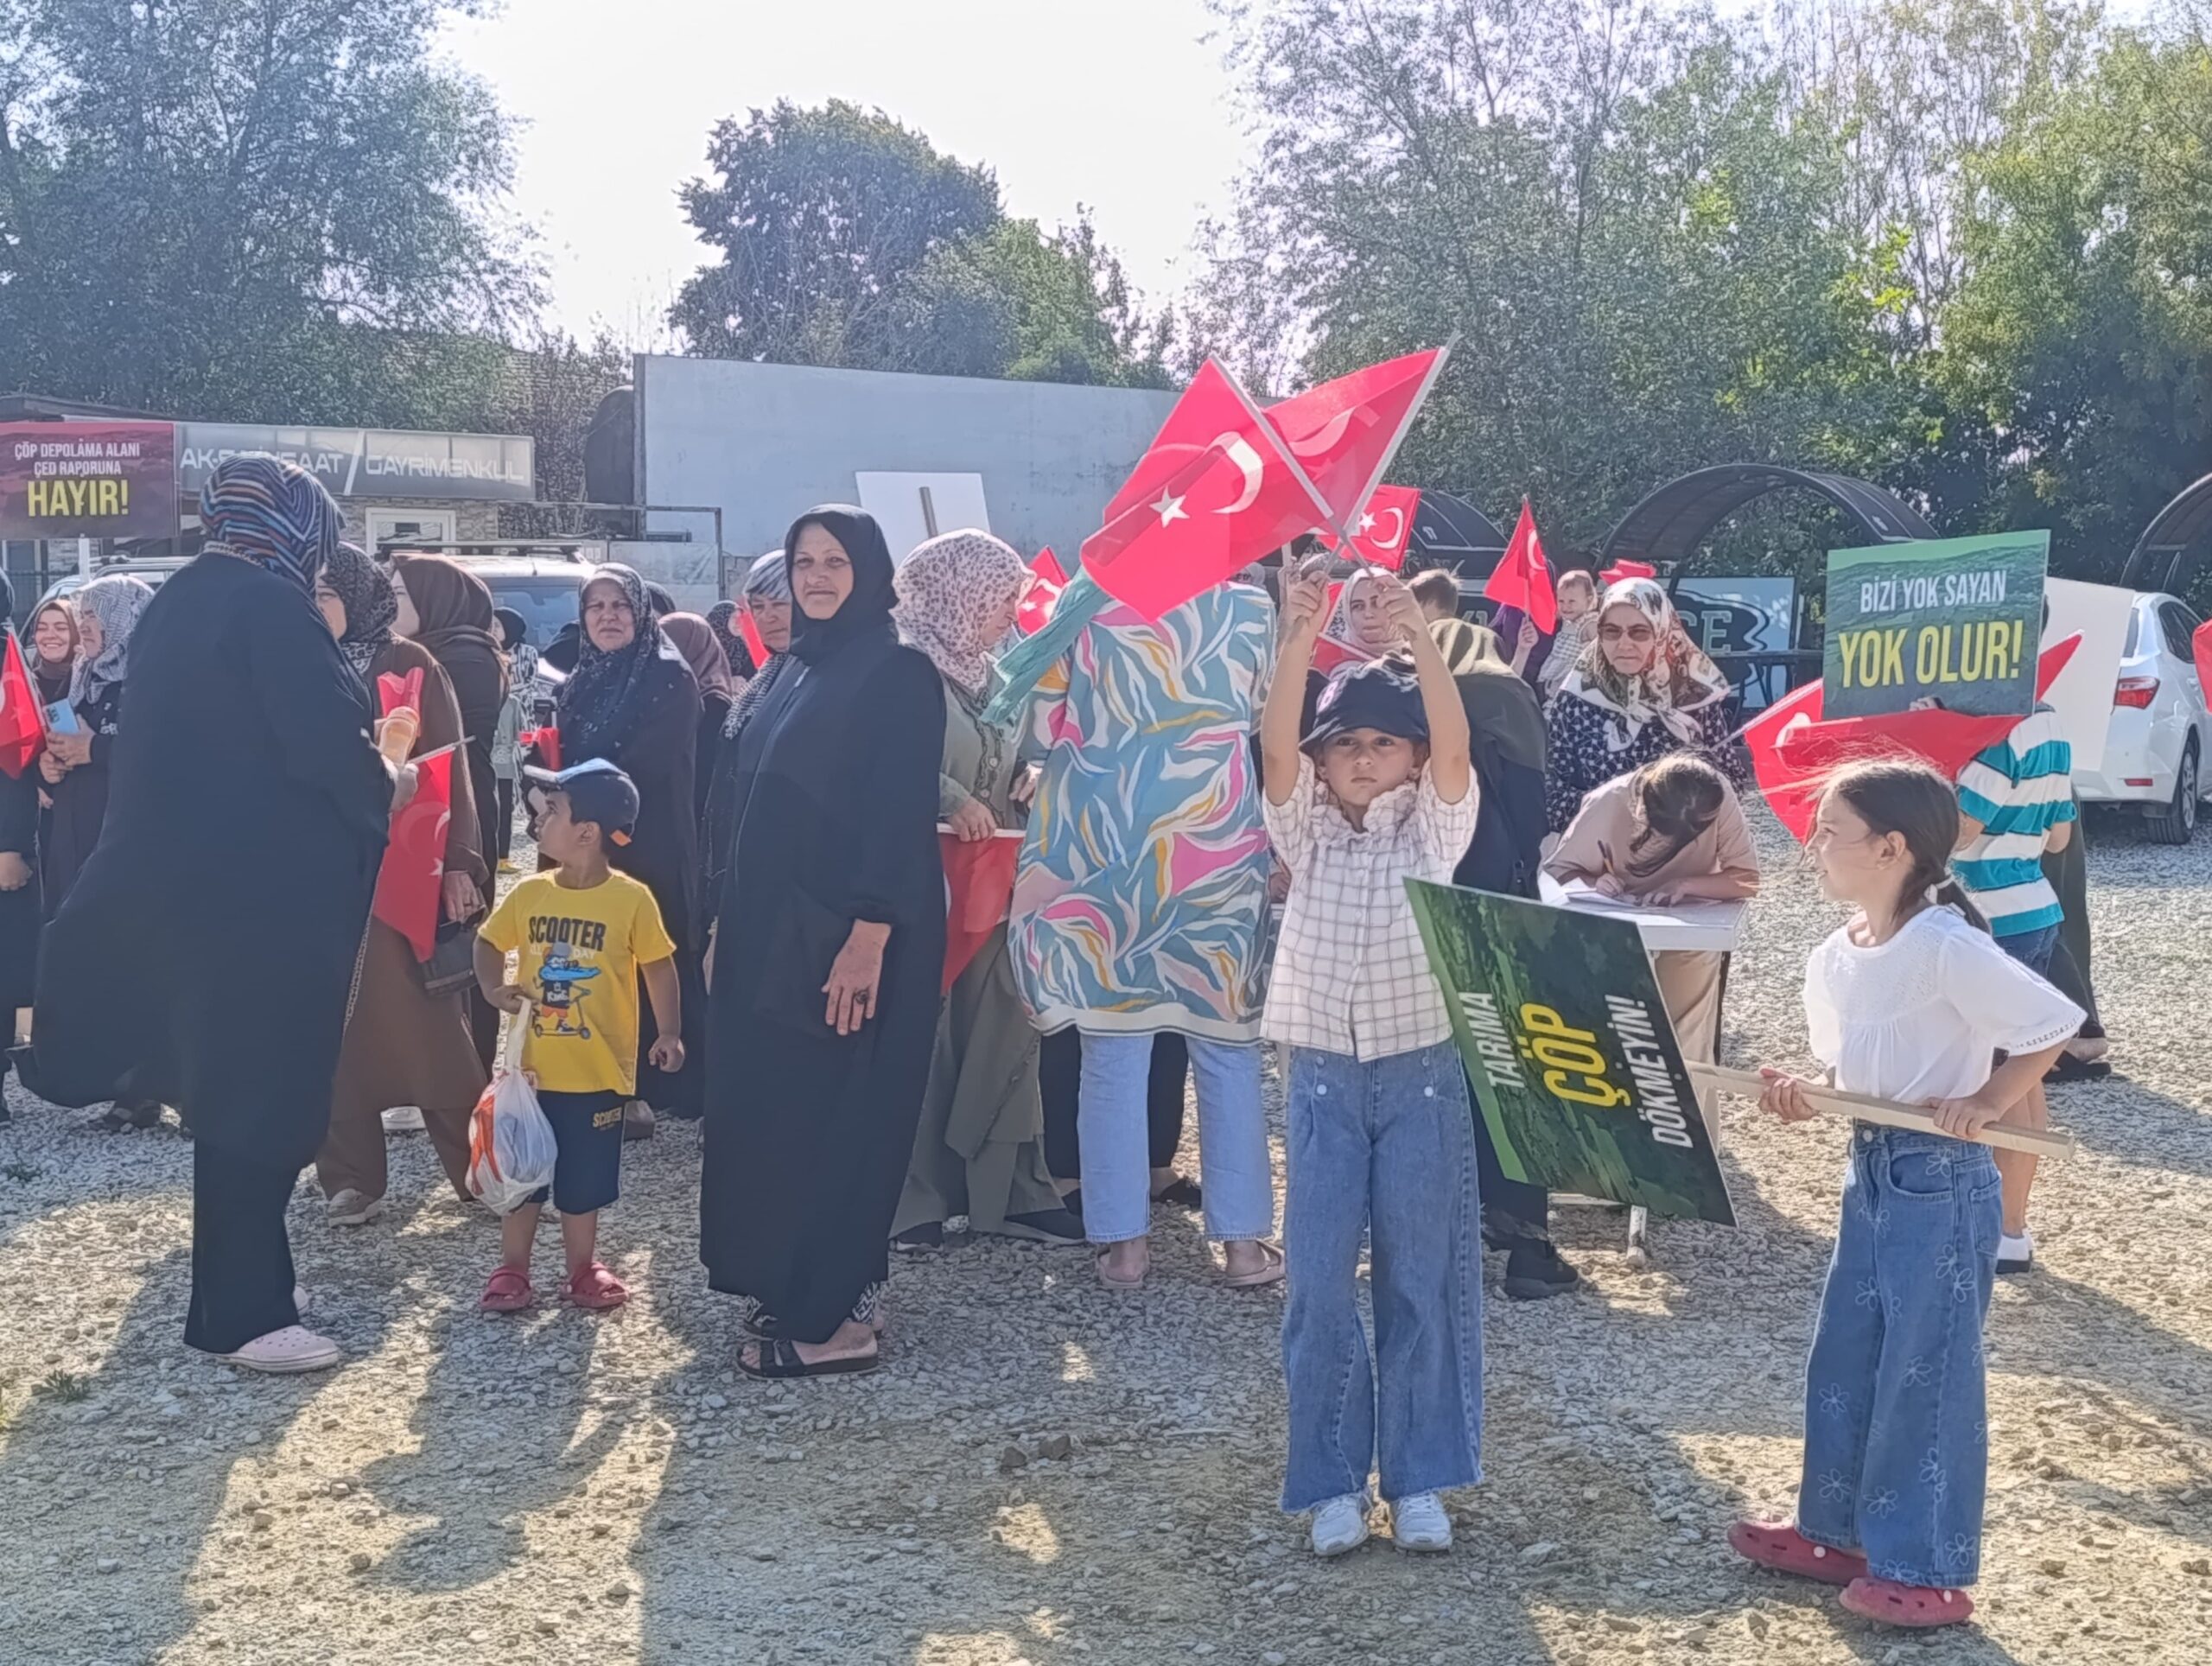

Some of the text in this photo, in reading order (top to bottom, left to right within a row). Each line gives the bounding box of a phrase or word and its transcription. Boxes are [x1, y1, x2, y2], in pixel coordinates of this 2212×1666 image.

[15, 442, 37, 461] ÇÖP
[105, 442, 140, 458] ALANI
[34, 460, 122, 478] ÇED RAPORUNA
[365, 452, 524, 480] GAYRİMENKUL
[28, 480, 129, 517] HAYIR!
[1859, 569, 2006, 614] BİZİ YOK SAYAN
[1838, 620, 2024, 688] YOK OLUR!
[528, 916, 607, 952] SCOOTER
[1459, 992, 1525, 1088] TARIMA
[1516, 1003, 1631, 1107] ÇÖP
[1605, 995, 1694, 1148] DÖKMEYİN!
